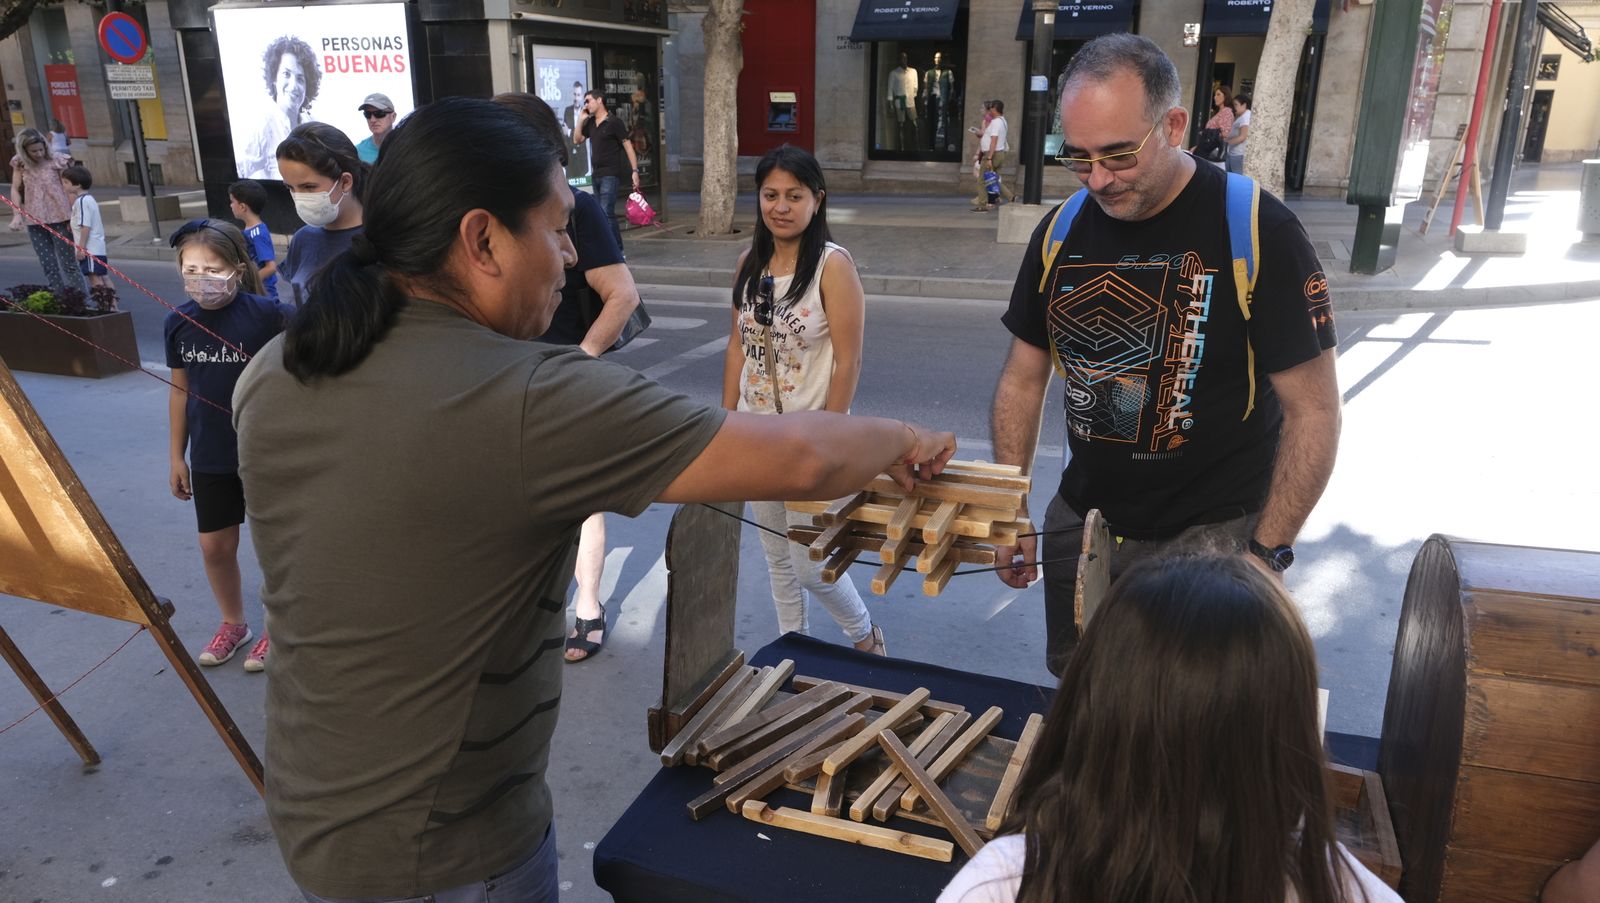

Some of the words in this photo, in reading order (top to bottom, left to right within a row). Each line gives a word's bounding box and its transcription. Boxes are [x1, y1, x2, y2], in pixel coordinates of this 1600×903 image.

[321, 36, 403, 51] PERSONAS
[323, 54, 405, 73] BUENAS
[540, 64, 560, 80] MÁS
[544, 79, 557, 89] DE
[540, 88, 562, 101] UNO
[1168, 274, 1214, 430] ETHEREAL
